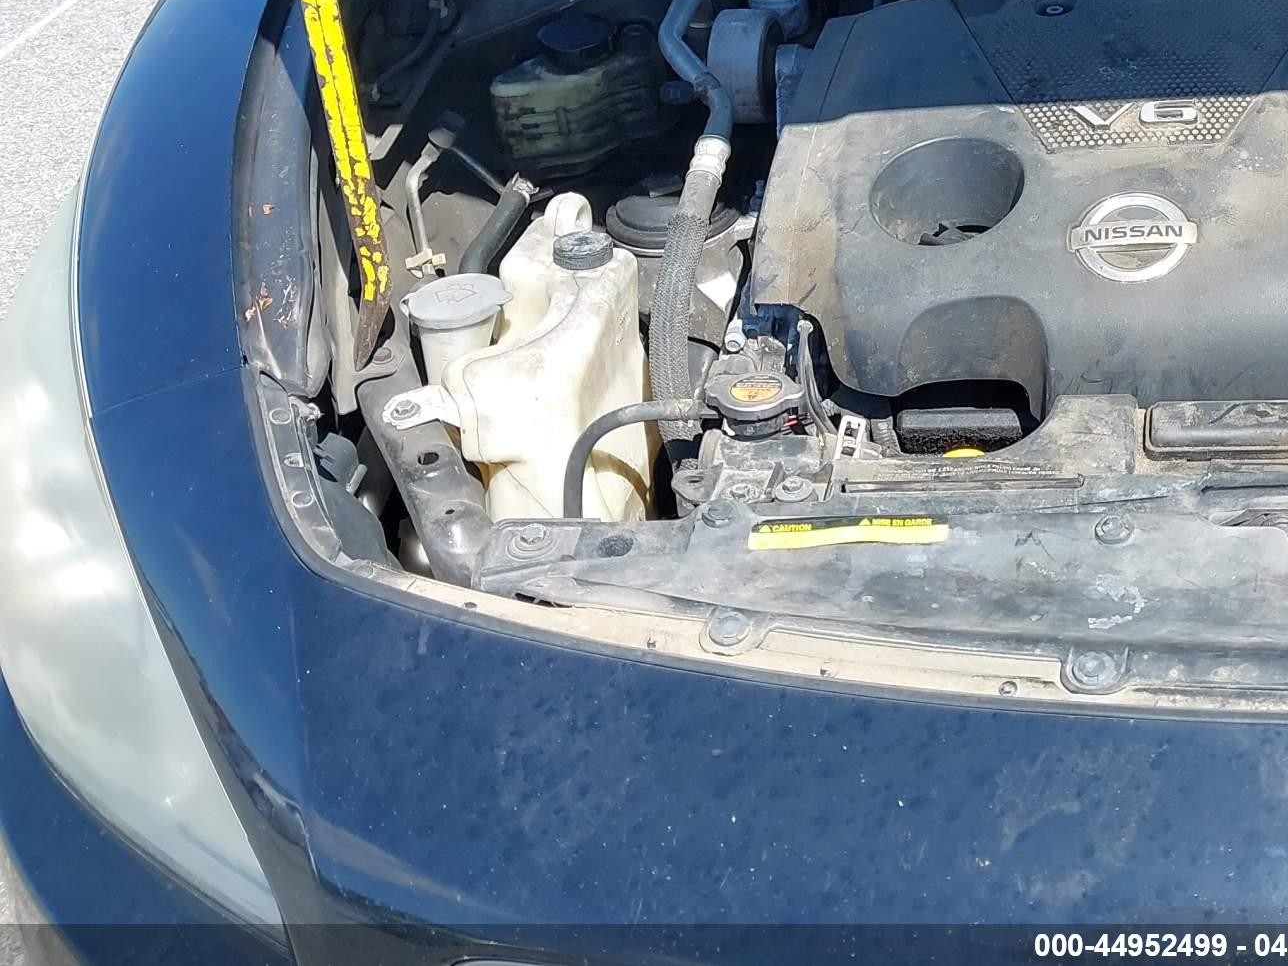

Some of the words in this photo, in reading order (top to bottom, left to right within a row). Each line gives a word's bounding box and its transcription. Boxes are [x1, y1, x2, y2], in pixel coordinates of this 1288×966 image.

[1070, 100, 1198, 131] V6
[1084, 225, 1184, 242] NISSAN
[772, 524, 812, 532] CAUTION
[872, 518, 891, 526] MISE
[905, 518, 933, 526] GARDE
